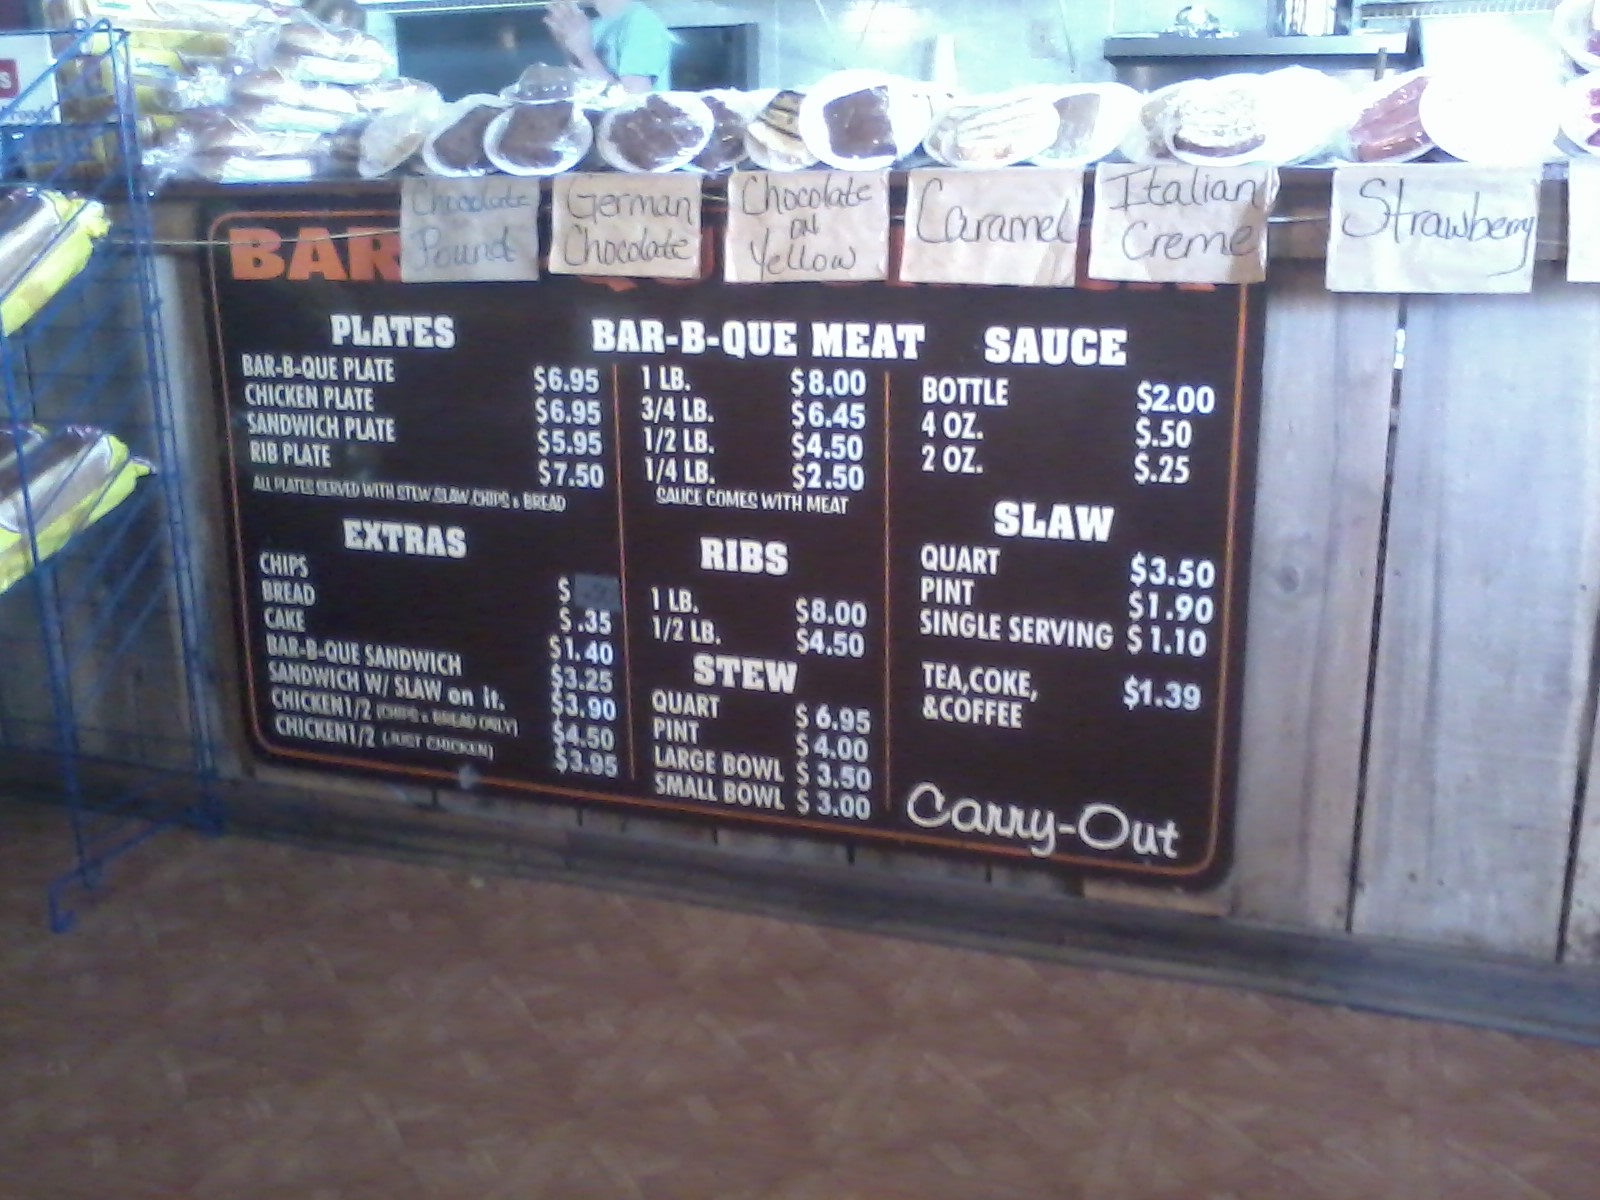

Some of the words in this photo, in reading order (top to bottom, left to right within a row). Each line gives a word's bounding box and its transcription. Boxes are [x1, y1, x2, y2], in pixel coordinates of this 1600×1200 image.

[566, 174, 692, 226] German
[743, 172, 873, 216] Chocolate
[1104, 167, 1268, 212] Italian
[916, 177, 1078, 244] Caramel
[1122, 219, 1257, 262] Creme
[1341, 177, 1536, 278] Strawberry
[564, 223, 693, 267] Chocolate
[750, 227, 857, 282] Yellow
[330, 314, 456, 349] PLATES
[591, 318, 798, 360] BAR-B-QUE
[811, 322, 926, 361] MEAT
[984, 327, 1129, 367] SAUCE
[241, 353, 337, 380] BAR-B-QUE
[343, 355, 396, 384] PLATE
[534, 366, 600, 396] $6.95
[641, 366, 652, 391] 1
[659, 366, 692, 393] LB.
[790, 368, 867, 400] $8.00
[244, 383, 319, 410] CHICKEN
[323, 386, 375, 412] PLATE
[922, 376, 1010, 407] BOTTLE
[1137, 380, 1216, 415] $2.00
[535, 397, 602, 427] $6.95
[641, 398, 677, 424] 3/4
[682, 398, 716, 425] LB.
[791, 400, 867, 432] $6.45
[921, 411, 936, 438] 4
[943, 412, 985, 441] OZ.
[246, 413, 341, 441] SANDWICH
[344, 416, 396, 444] PLATE
[537, 428, 603, 458] $5.95
[643, 426, 679, 454] 1/2
[682, 428, 716, 455] LB.
[1135, 418, 1193, 449] $.50
[250, 442, 280, 466] RIB
[283, 443, 333, 469] PLATE
[791, 431, 864, 462] $4.50
[921, 444, 936, 473] 2
[943, 446, 984, 475] OZ.
[538, 460, 605, 490] $7.50
[644, 458, 678, 484] 1/4
[683, 458, 716, 485] LB.
[792, 461, 866, 492] $2.50
[1134, 452, 1191, 485] $.25
[362, 482, 395, 500] WITH
[523, 491, 567, 513] BREAD
[656, 486, 703, 507] SAUCE
[706, 489, 759, 510] COMES
[761, 493, 802, 512] WITH
[806, 495, 850, 515] MEAT
[994, 500, 1115, 542] SLAW
[343, 518, 468, 560] EXTRAS
[260, 551, 309, 579] CHIPS
[700, 536, 790, 577] RIBS
[920, 543, 1001, 576] QUART
[1130, 551, 1216, 590] $3.50
[261, 580, 316, 606] BREAD
[651, 587, 660, 611] 1
[668, 588, 700, 615] LB.
[920, 576, 975, 606] PINT
[264, 608, 306, 633] CAKE
[796, 597, 868, 629] $8.00
[1128, 590, 1215, 625] $1.90
[652, 615, 684, 642] 1/2
[690, 618, 722, 645] LB.
[796, 629, 866, 659] $4.50
[920, 608, 1001, 643] SINGLE
[1008, 614, 1115, 652] SERVING
[265, 633, 361, 666] BAR-B-QUE
[365, 644, 462, 677] SANDWICH
[268, 661, 360, 693] SANDWICH
[364, 671, 389, 697] W/
[394, 674, 442, 702] SLAW
[448, 687, 474, 707] on
[551, 663, 614, 695] $3.25
[693, 653, 798, 694] STEW
[922, 662, 1039, 702] TEA,COKE,
[551, 690, 617, 721] $3.90
[652, 692, 720, 719] QUART
[1123, 675, 1202, 710] $1.39
[923, 694, 1024, 729] &COFFEE
[553, 718, 615, 751] $4.50
[653, 719, 700, 745] PINT
[553, 745, 619, 778] $3.95
[654, 746, 717, 774] LARGE
[722, 754, 784, 783] BOWL
[654, 775, 717, 803] SMALL
[723, 782, 785, 812] BOWL
[906, 782, 1180, 858] Carry-Out
